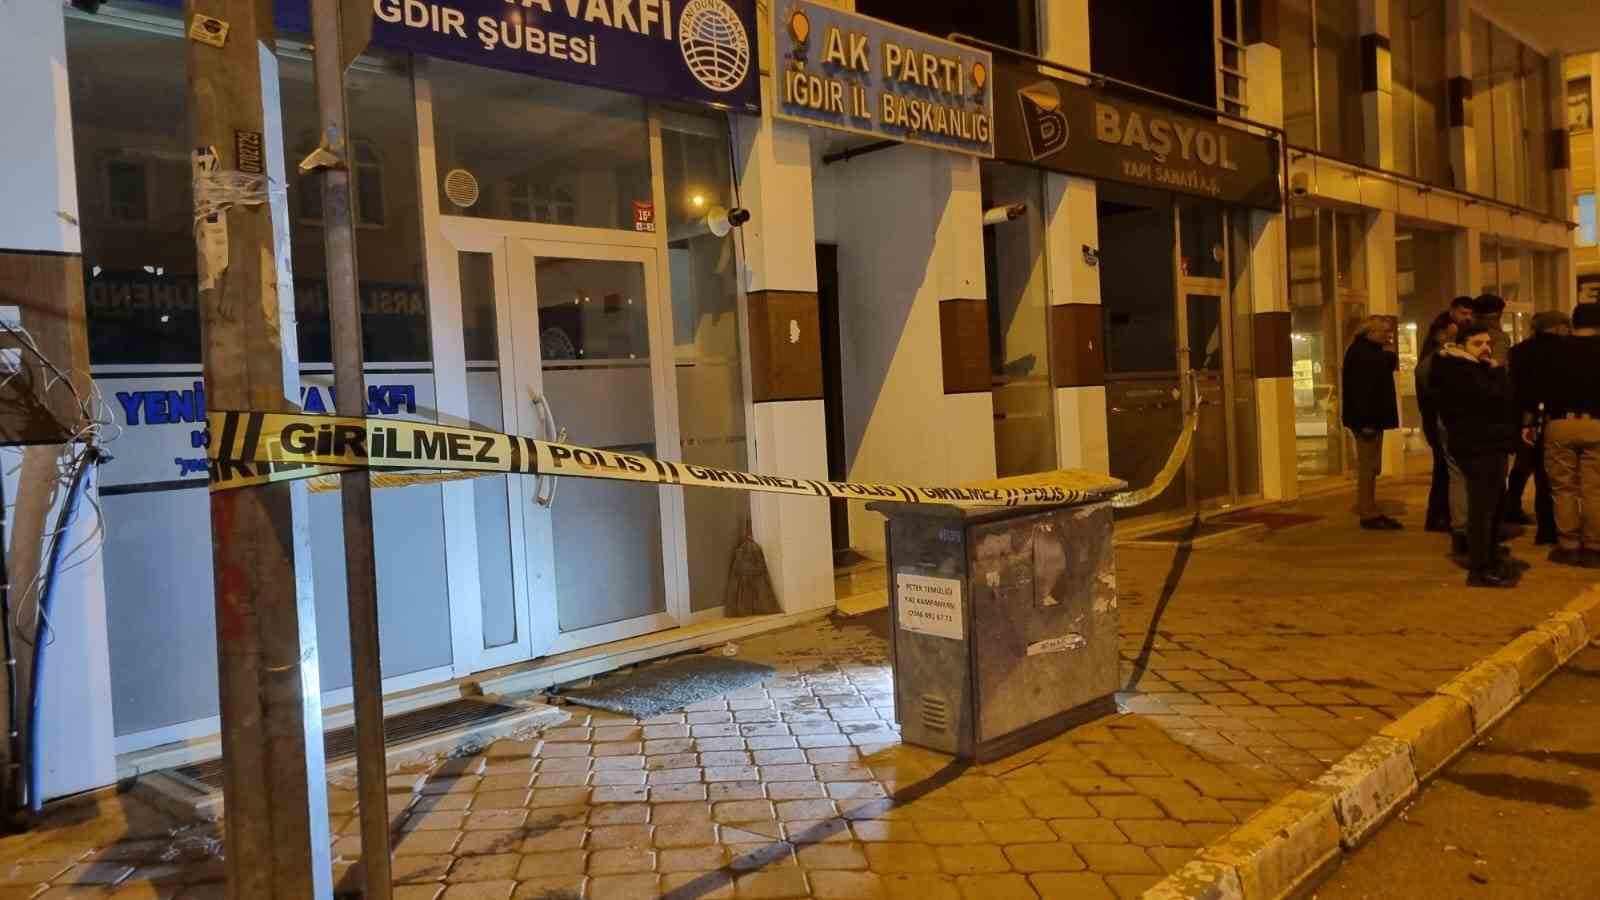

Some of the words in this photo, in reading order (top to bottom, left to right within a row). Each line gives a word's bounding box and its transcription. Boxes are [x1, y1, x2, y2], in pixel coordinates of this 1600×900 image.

[477, 15, 597, 66] ŞUBESİ
[826, 27, 870, 72] AK
[885, 43, 964, 96] PARTİ
[1095, 102, 1238, 170] BAŞYOL
[1121, 159, 1151, 181] YAPI
[115, 381, 205, 425] YENİ
[547, 444, 647, 474] POLİS
